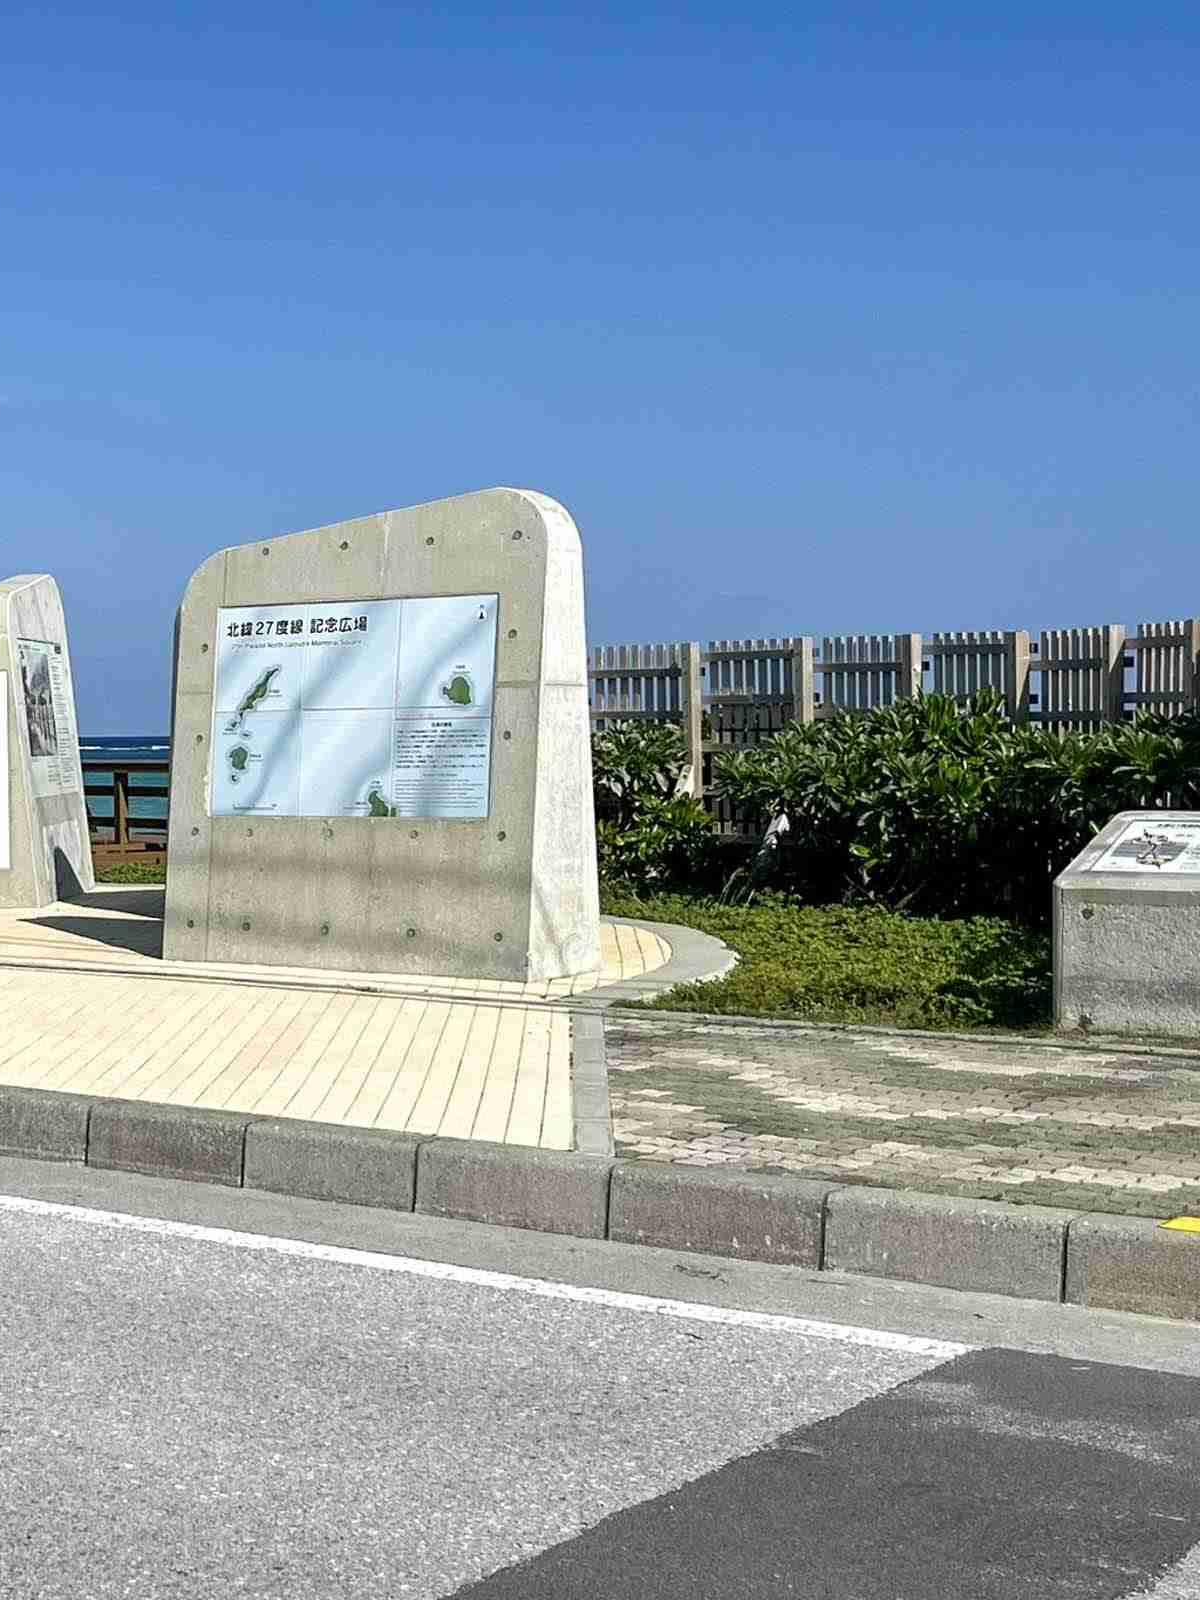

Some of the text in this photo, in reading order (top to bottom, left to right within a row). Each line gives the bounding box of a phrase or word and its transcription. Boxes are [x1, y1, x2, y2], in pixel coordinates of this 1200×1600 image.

[227, 616, 367, 637] 北緯27度線 記念広場
